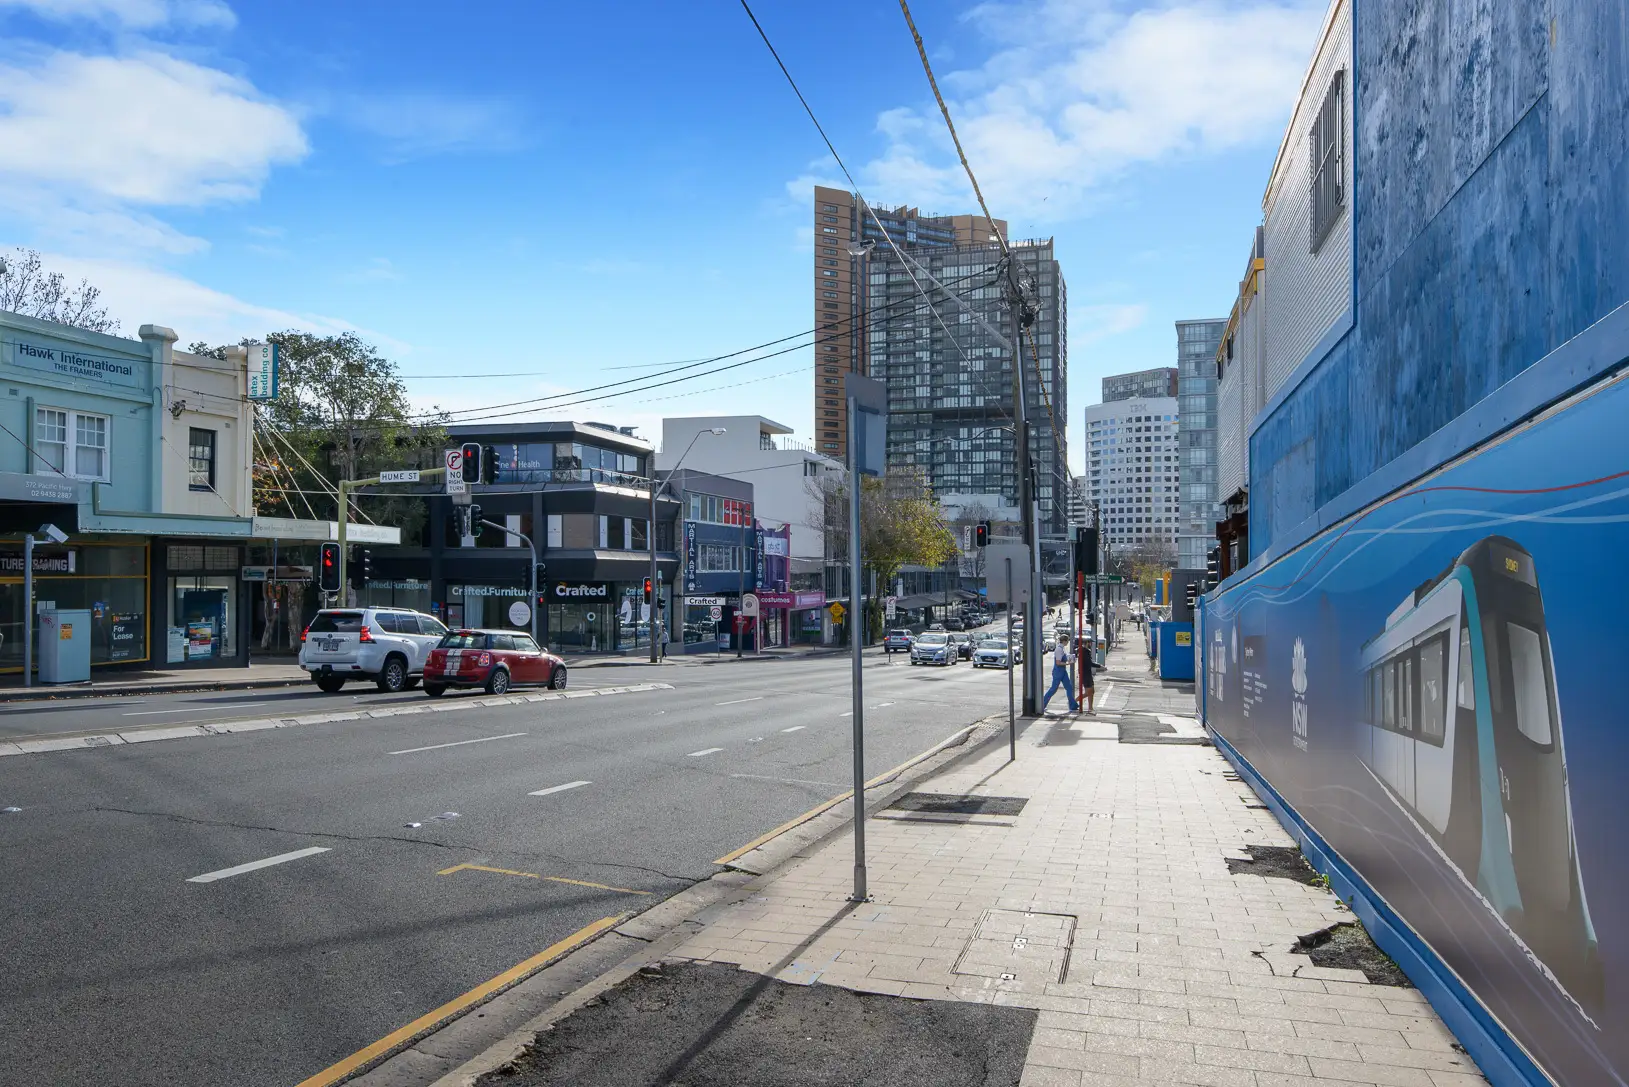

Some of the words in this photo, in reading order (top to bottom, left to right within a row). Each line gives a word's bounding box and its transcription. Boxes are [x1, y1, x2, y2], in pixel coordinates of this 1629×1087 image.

[20, 343, 54, 360] Hawk
[60, 351, 132, 376] International
[54, 363, 68, 372] THE
[70, 366, 103, 378] FRAMERS
[260, 360, 270, 396] bedding
[249, 375, 258, 397] latex
[518, 460, 540, 468] Health
[687, 523, 696, 557] MARTIAL
[32, 559, 67, 571] RAMING
[556, 584, 606, 596] Crafted
[113, 625, 125, 633] For
[1292, 701, 1308, 738] NSW
